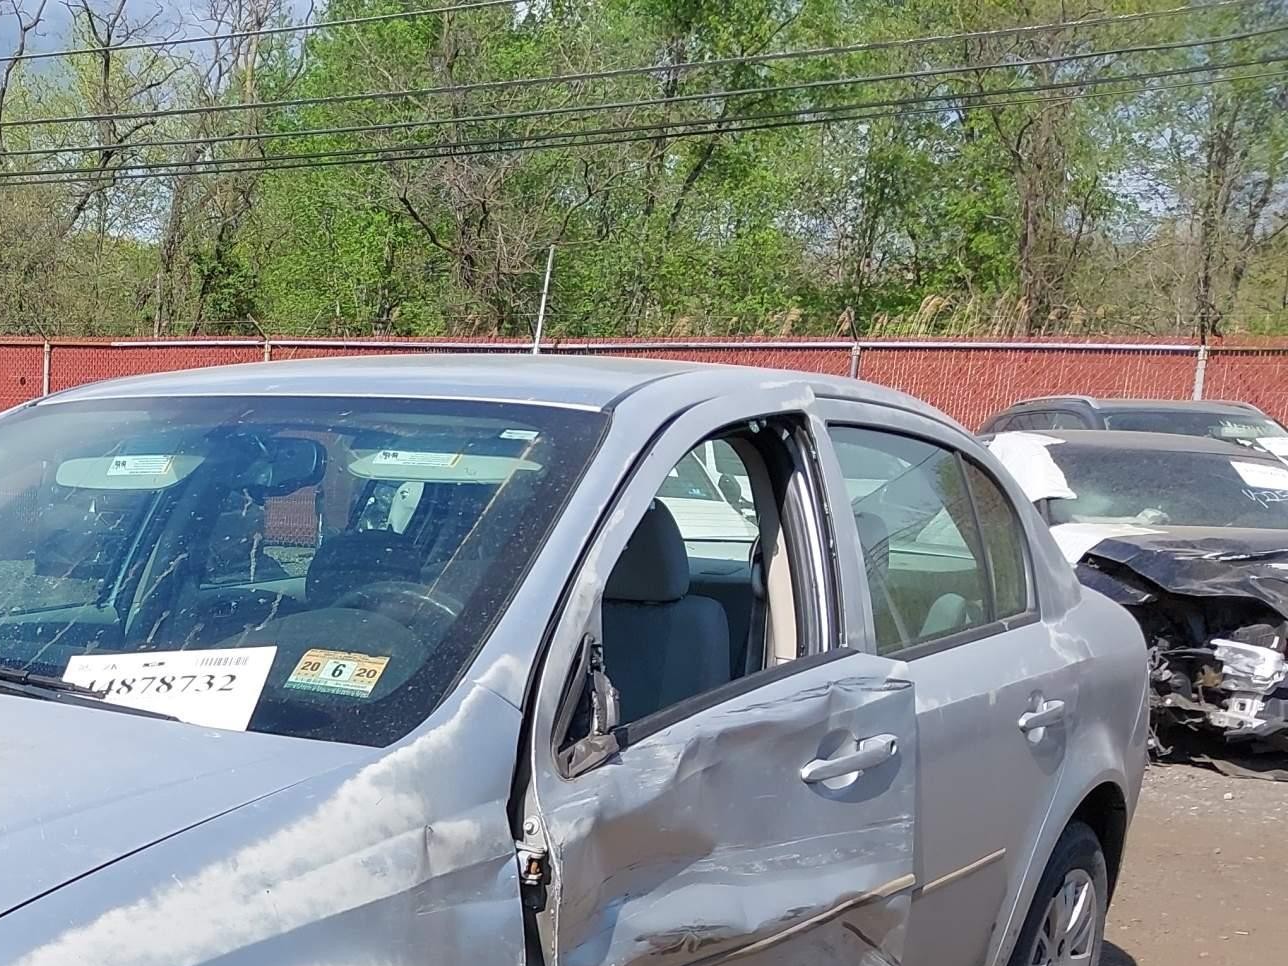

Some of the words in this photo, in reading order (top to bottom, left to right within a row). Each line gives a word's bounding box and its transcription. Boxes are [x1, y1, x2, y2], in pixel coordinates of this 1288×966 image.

[300, 661, 321, 672] 20
[331, 663, 346, 678] 6
[355, 668, 378, 679] 20
